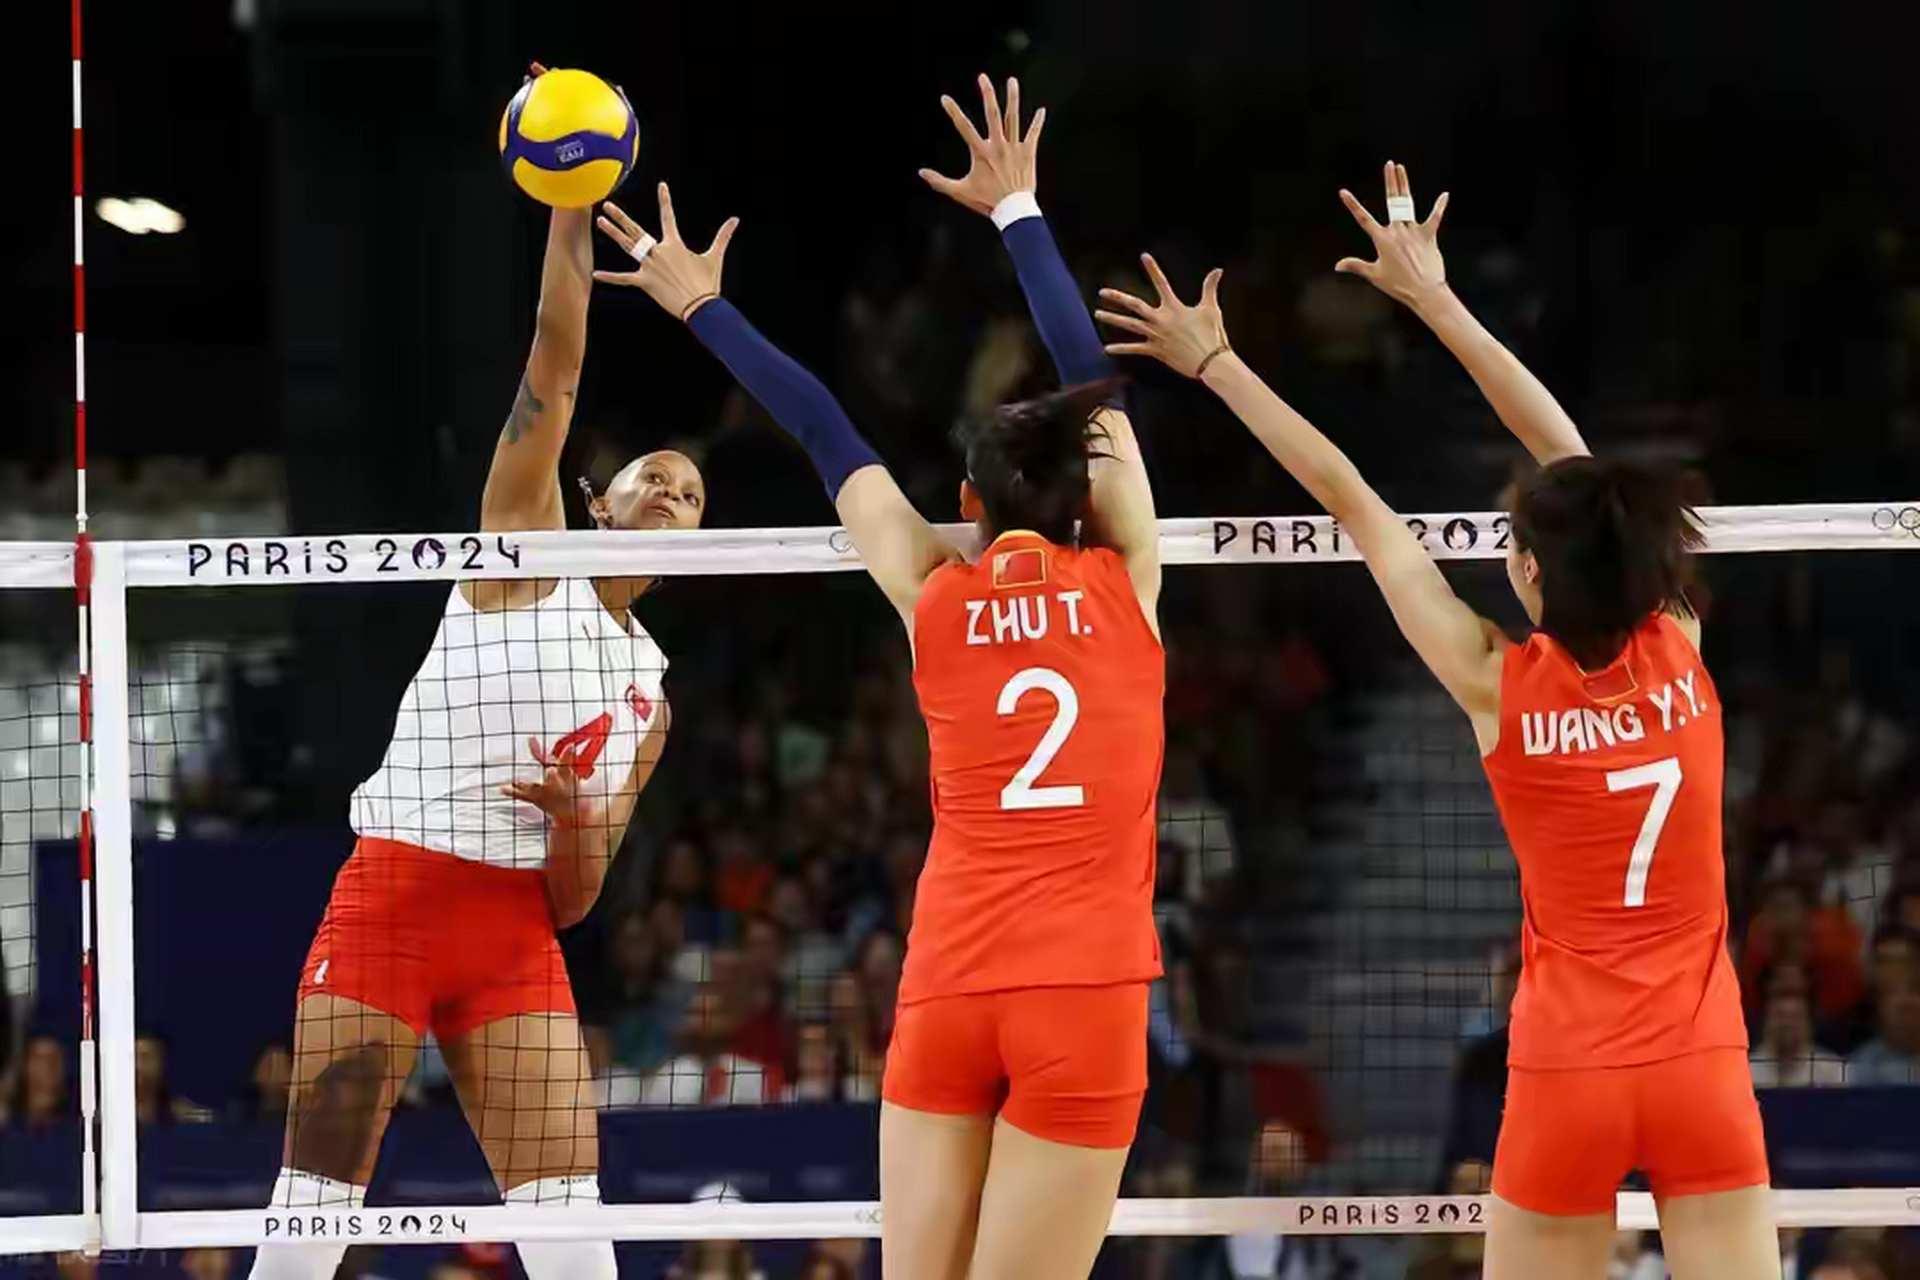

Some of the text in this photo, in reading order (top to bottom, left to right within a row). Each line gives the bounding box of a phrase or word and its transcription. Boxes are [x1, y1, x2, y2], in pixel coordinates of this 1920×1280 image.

[966, 590, 1093, 645] ZHU T.
[552, 711, 613, 780] 4
[996, 667, 1084, 810] 2
[1521, 669, 1707, 756] WANG Y.Y.
[1607, 757, 1683, 908] 7
